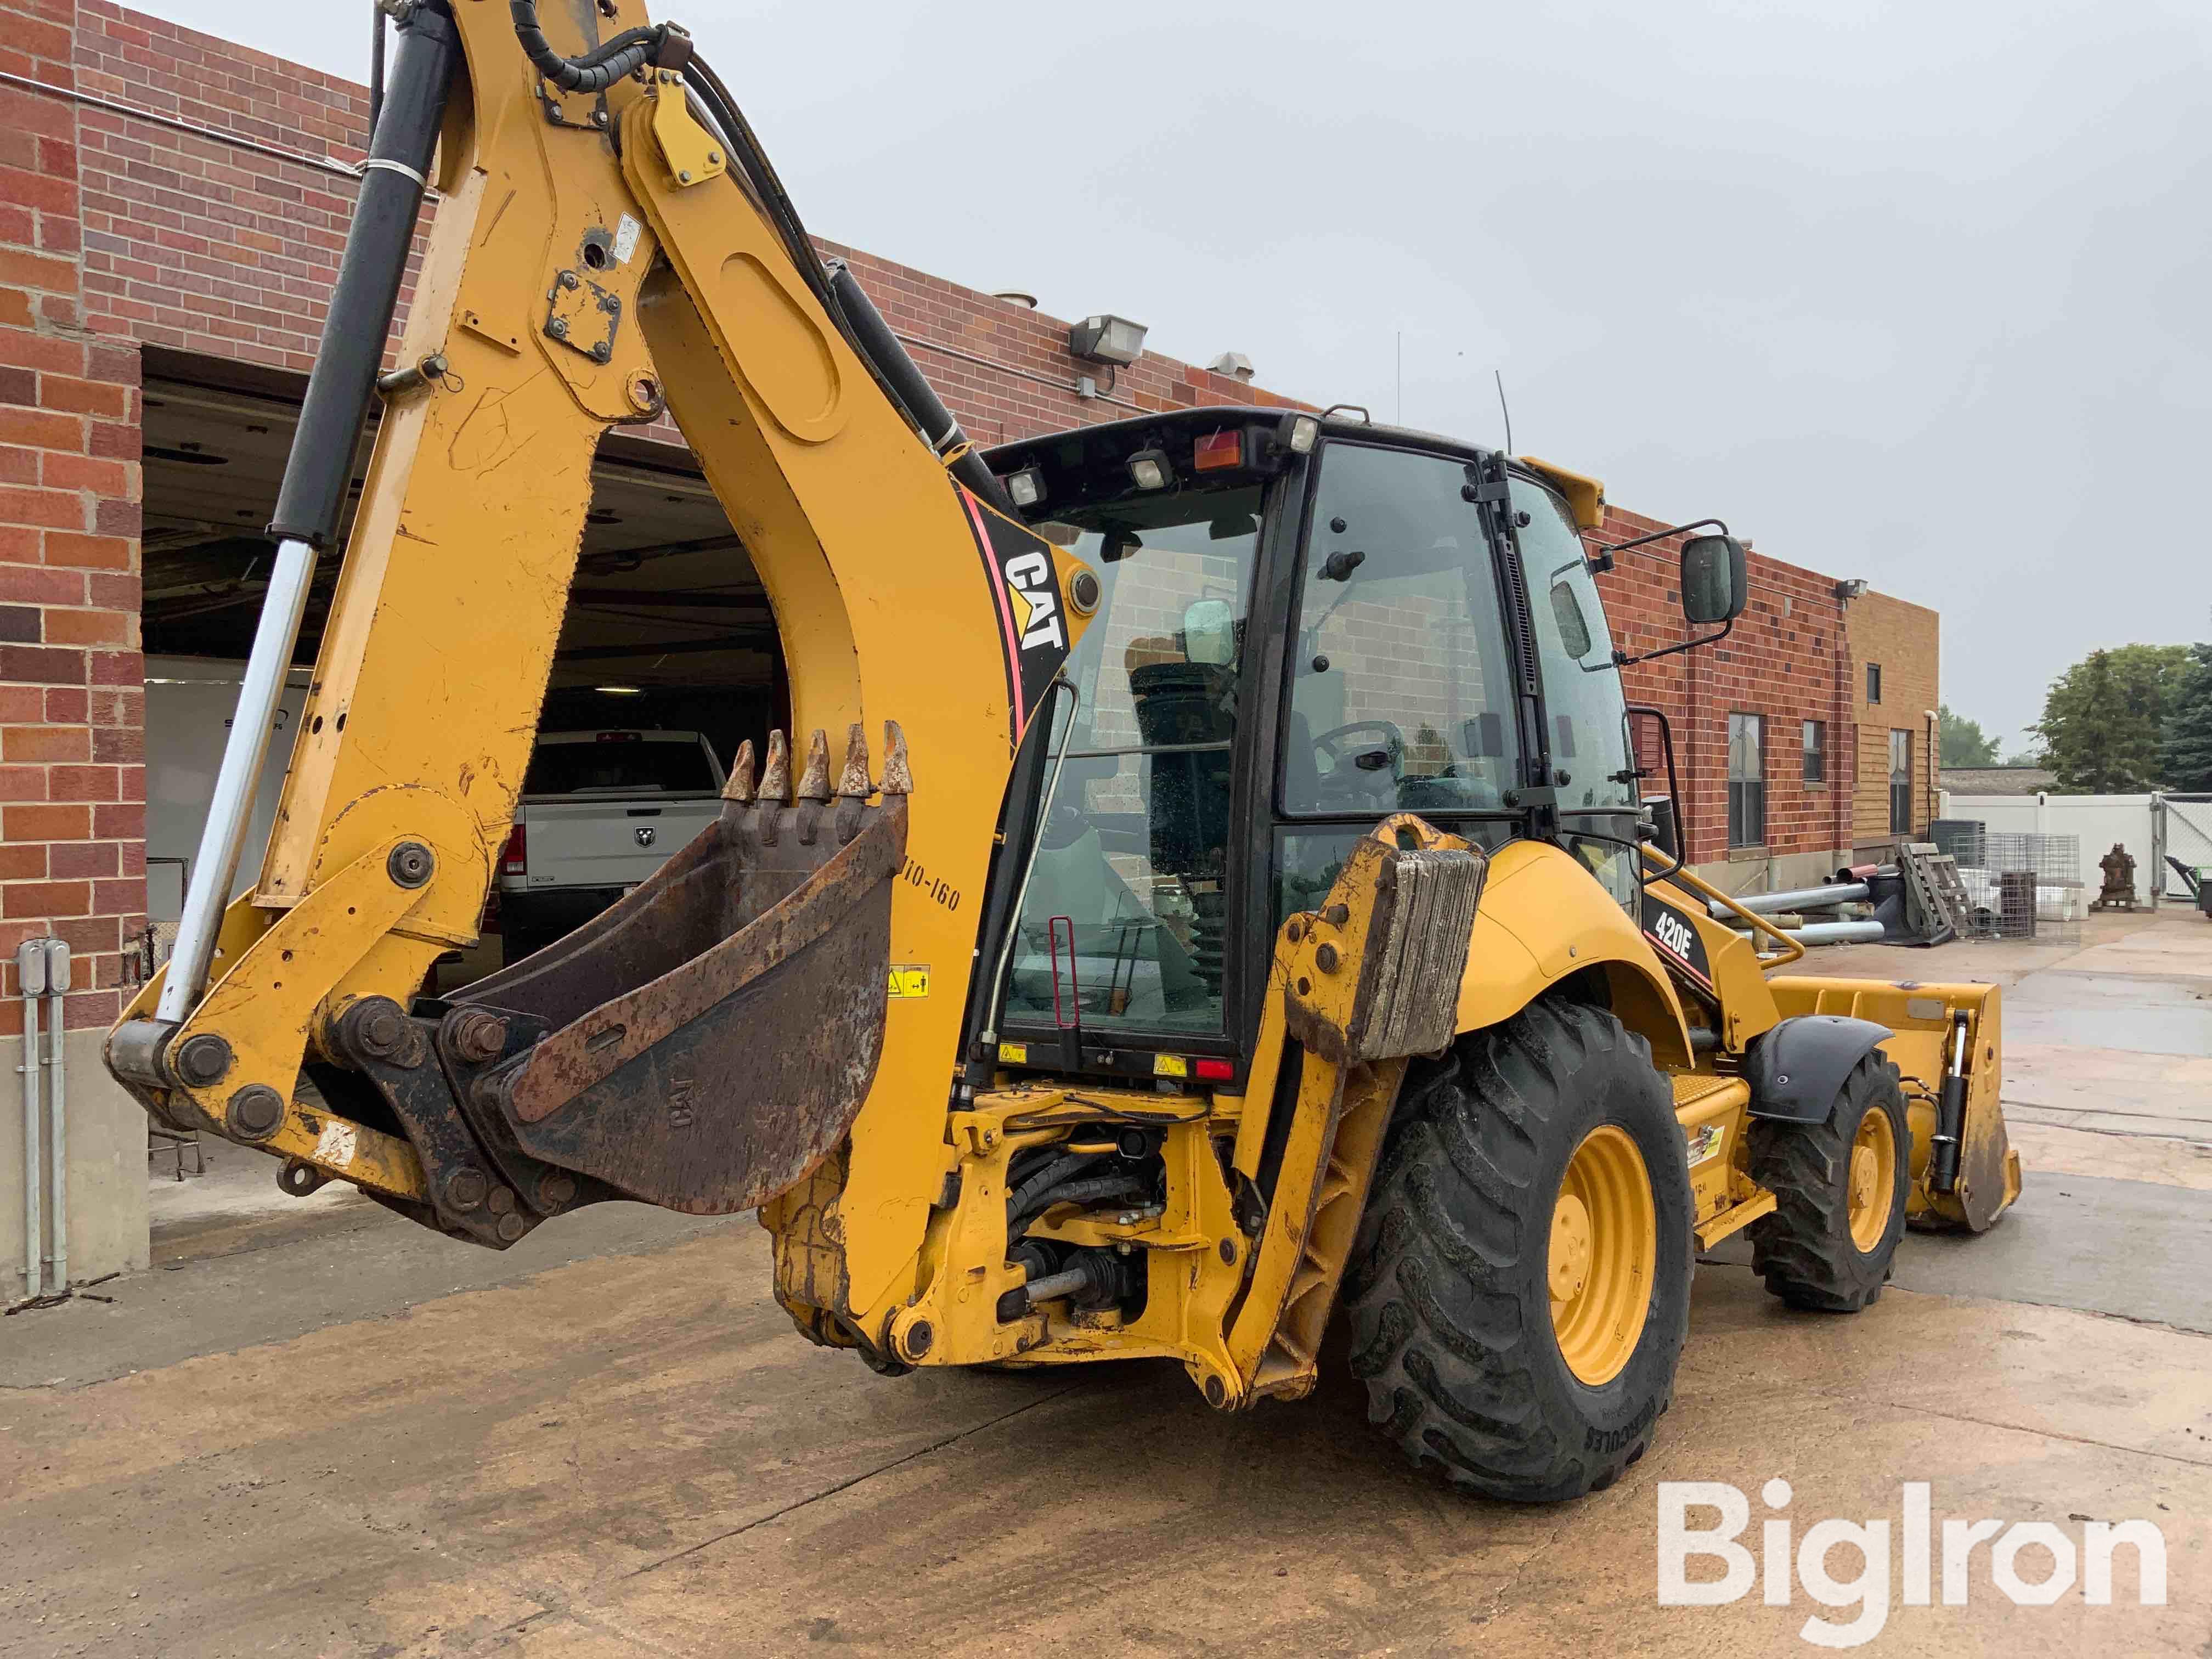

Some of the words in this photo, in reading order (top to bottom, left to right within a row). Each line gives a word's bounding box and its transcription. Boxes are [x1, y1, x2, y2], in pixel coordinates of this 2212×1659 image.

[1006, 552, 1063, 651] CAT
[1655, 911, 1692, 960] 420E
[668, 1078, 694, 1127] CAT
